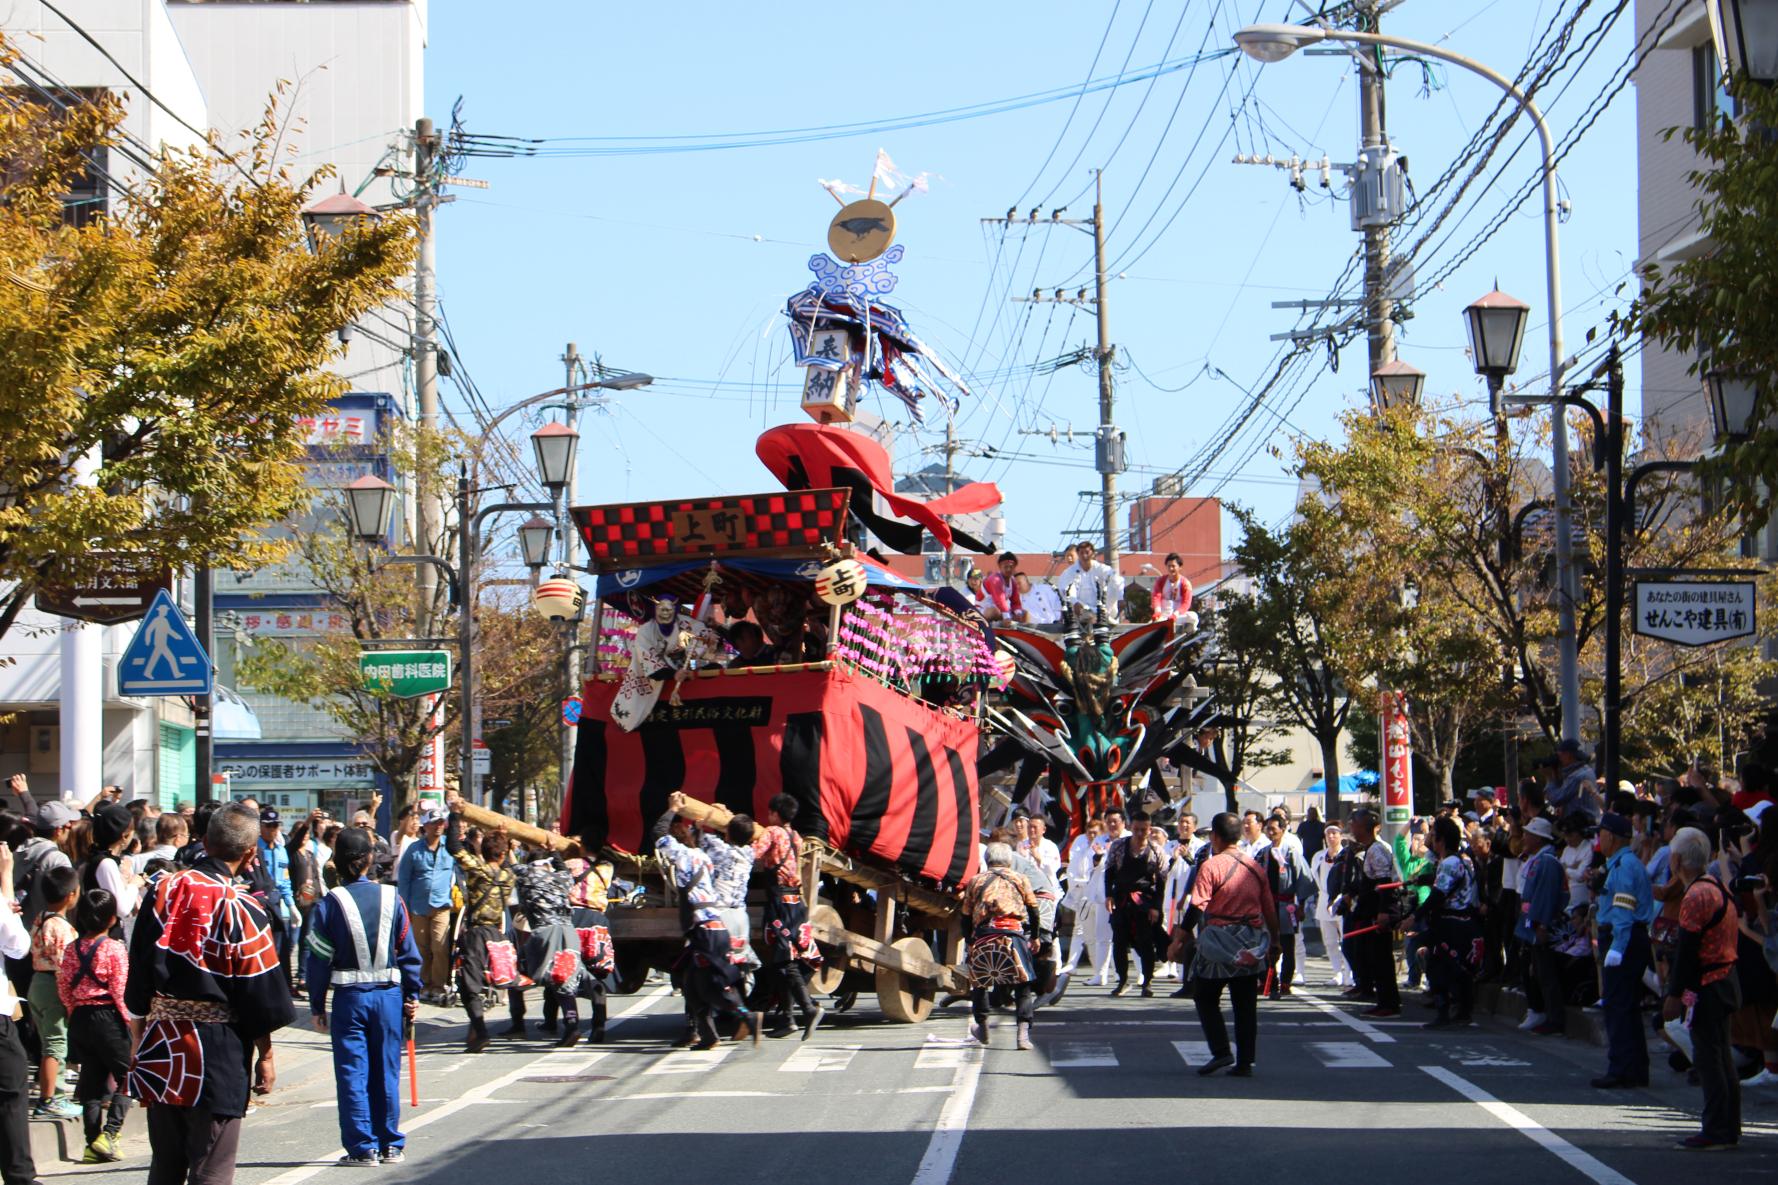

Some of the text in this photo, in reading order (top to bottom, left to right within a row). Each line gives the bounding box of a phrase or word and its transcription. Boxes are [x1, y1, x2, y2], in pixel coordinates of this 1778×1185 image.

[682, 511, 739, 542] 上町
[831, 568, 857, 597] 上町
[1647, 590, 1744, 604] あなたの街の建具屋さん
[1645, 607, 1747, 631] せんこや建具(有)
[363, 662, 447, 680] 内田歯科医院
[221, 764, 368, 779] 安心の保護者サポート体制
